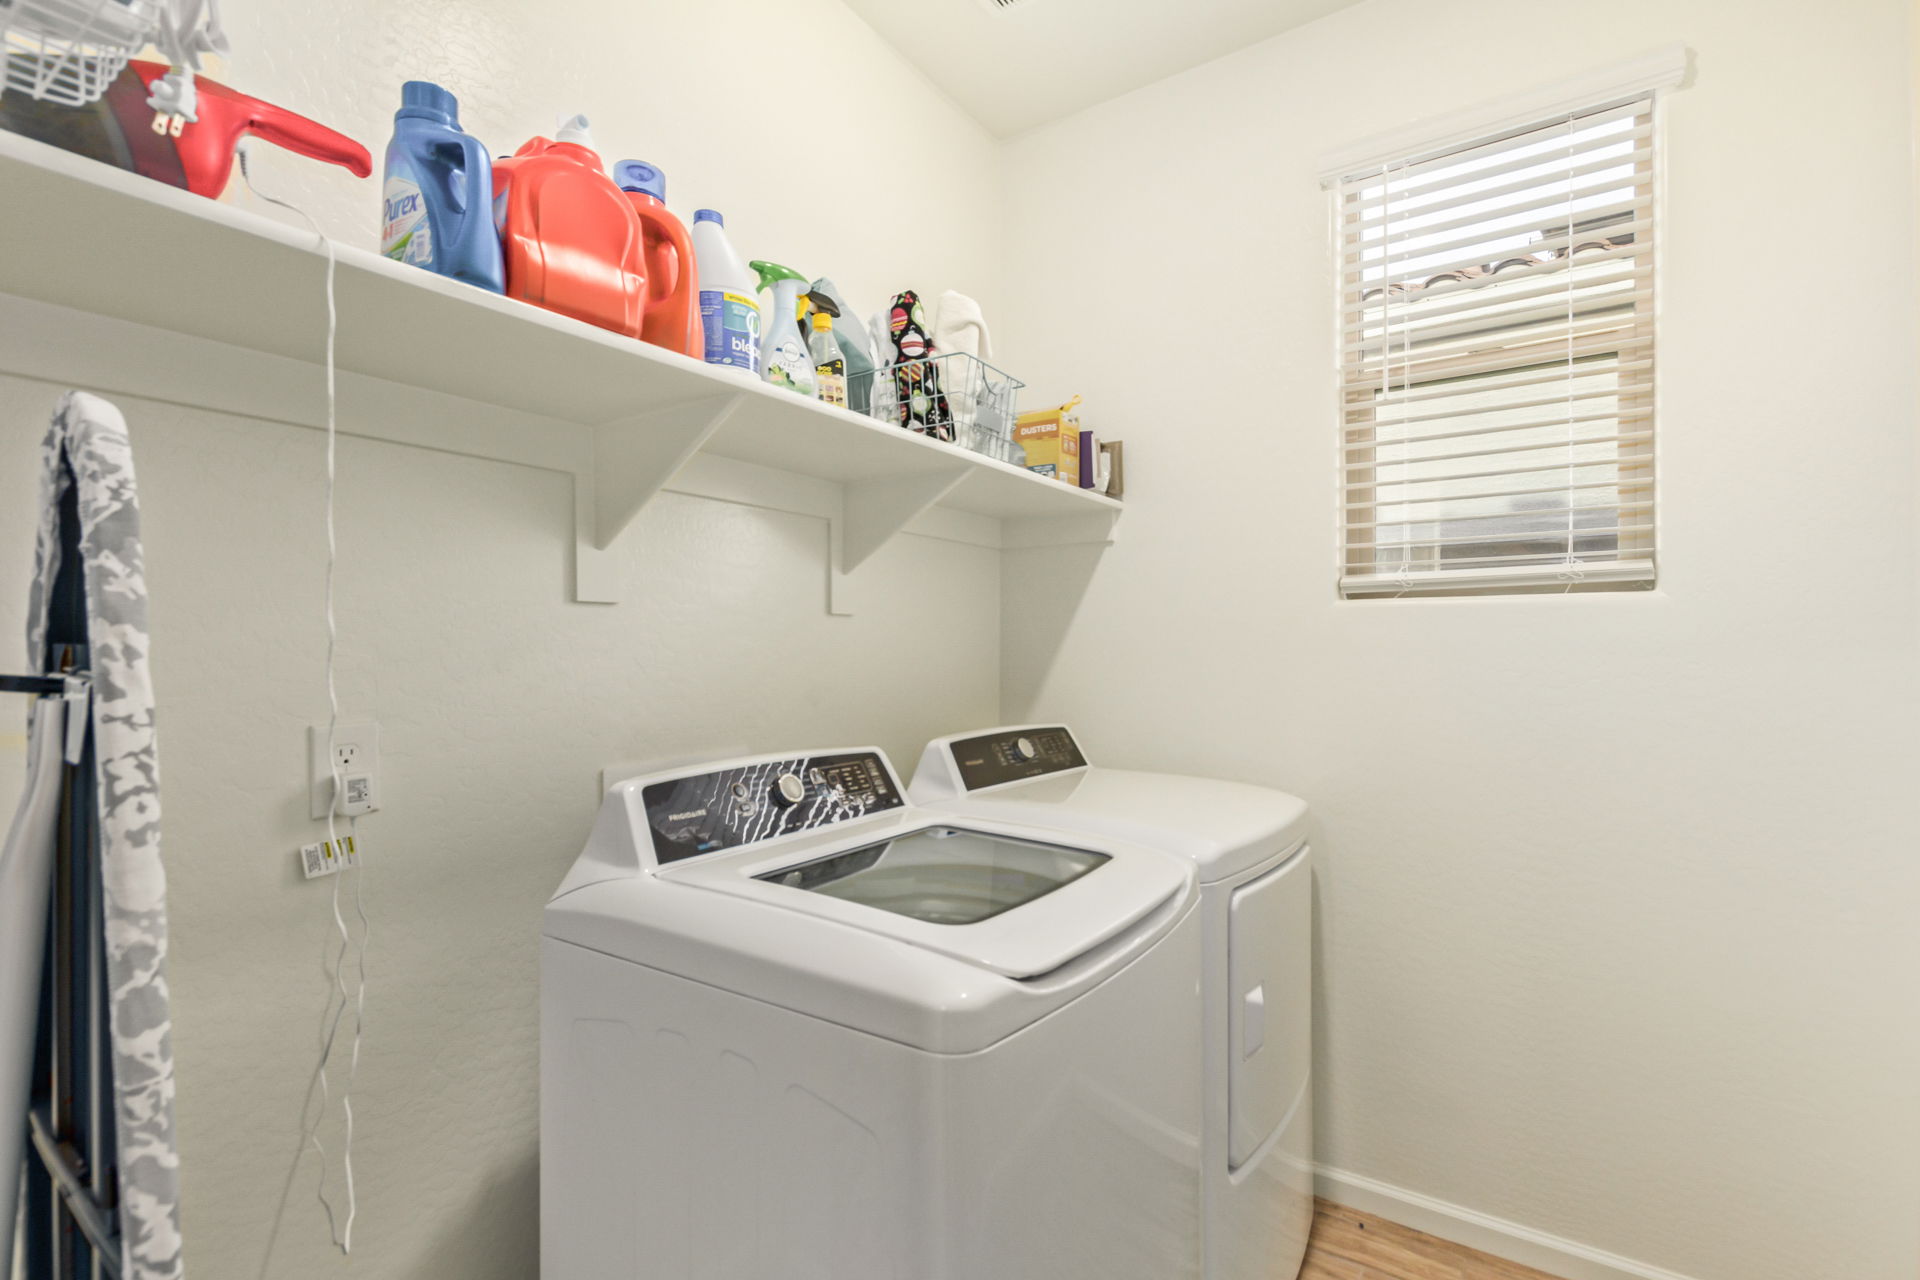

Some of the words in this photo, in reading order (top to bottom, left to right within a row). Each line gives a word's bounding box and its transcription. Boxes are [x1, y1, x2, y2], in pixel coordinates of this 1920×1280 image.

[384, 193, 420, 222] Purex
[1020, 424, 1058, 435] DUSTERS
[668, 809, 707, 822] FRIGIDAIRE
